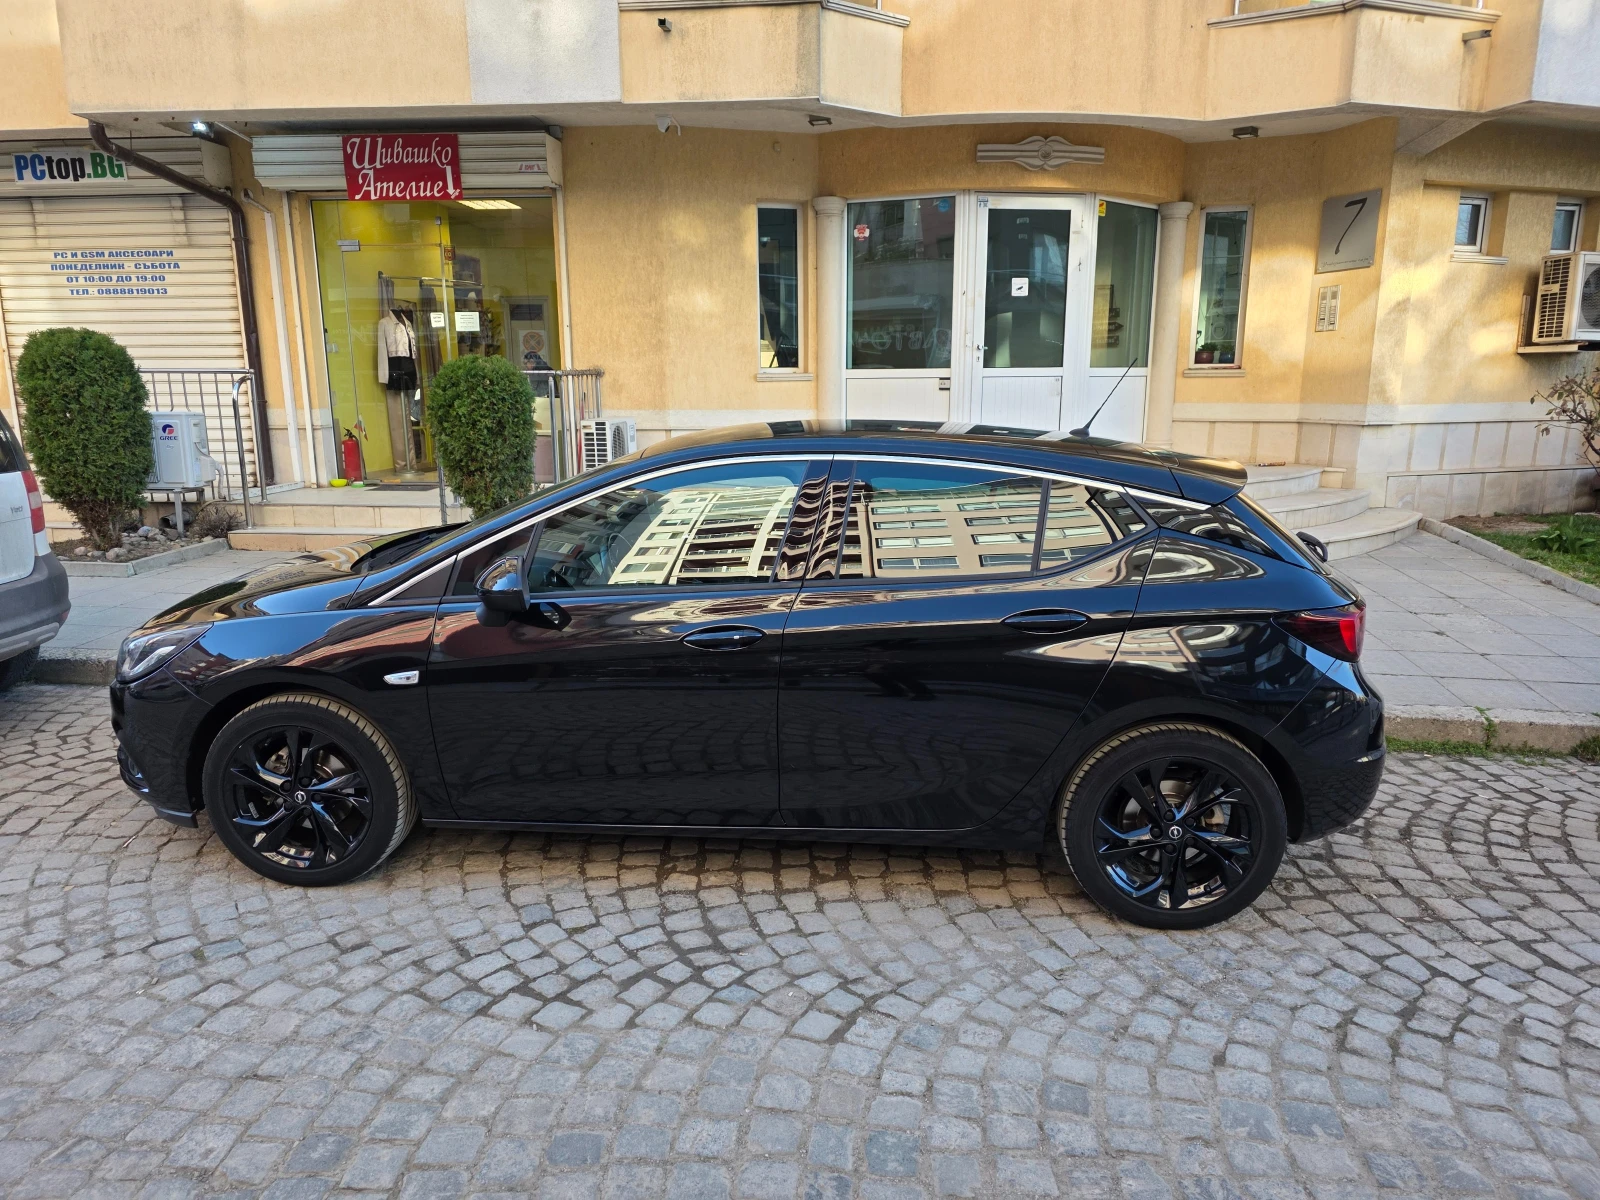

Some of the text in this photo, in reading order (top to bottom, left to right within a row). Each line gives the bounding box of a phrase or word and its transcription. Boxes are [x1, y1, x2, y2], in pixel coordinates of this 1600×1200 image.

[14, 152, 125, 182] PCtop.BG
[347, 137, 452, 169] Шивашко
[354, 168, 445, 200] Ателие
[1334, 197, 1368, 255] 7
[50, 263, 125, 271] ПОНЕДЕЛНИК
[134, 262, 181, 270] СЪБОТА
[107, 250, 174, 258] АКСЕСОАРИ
[82, 275, 113, 283] 10:00
[115, 275, 133, 283] ДО
